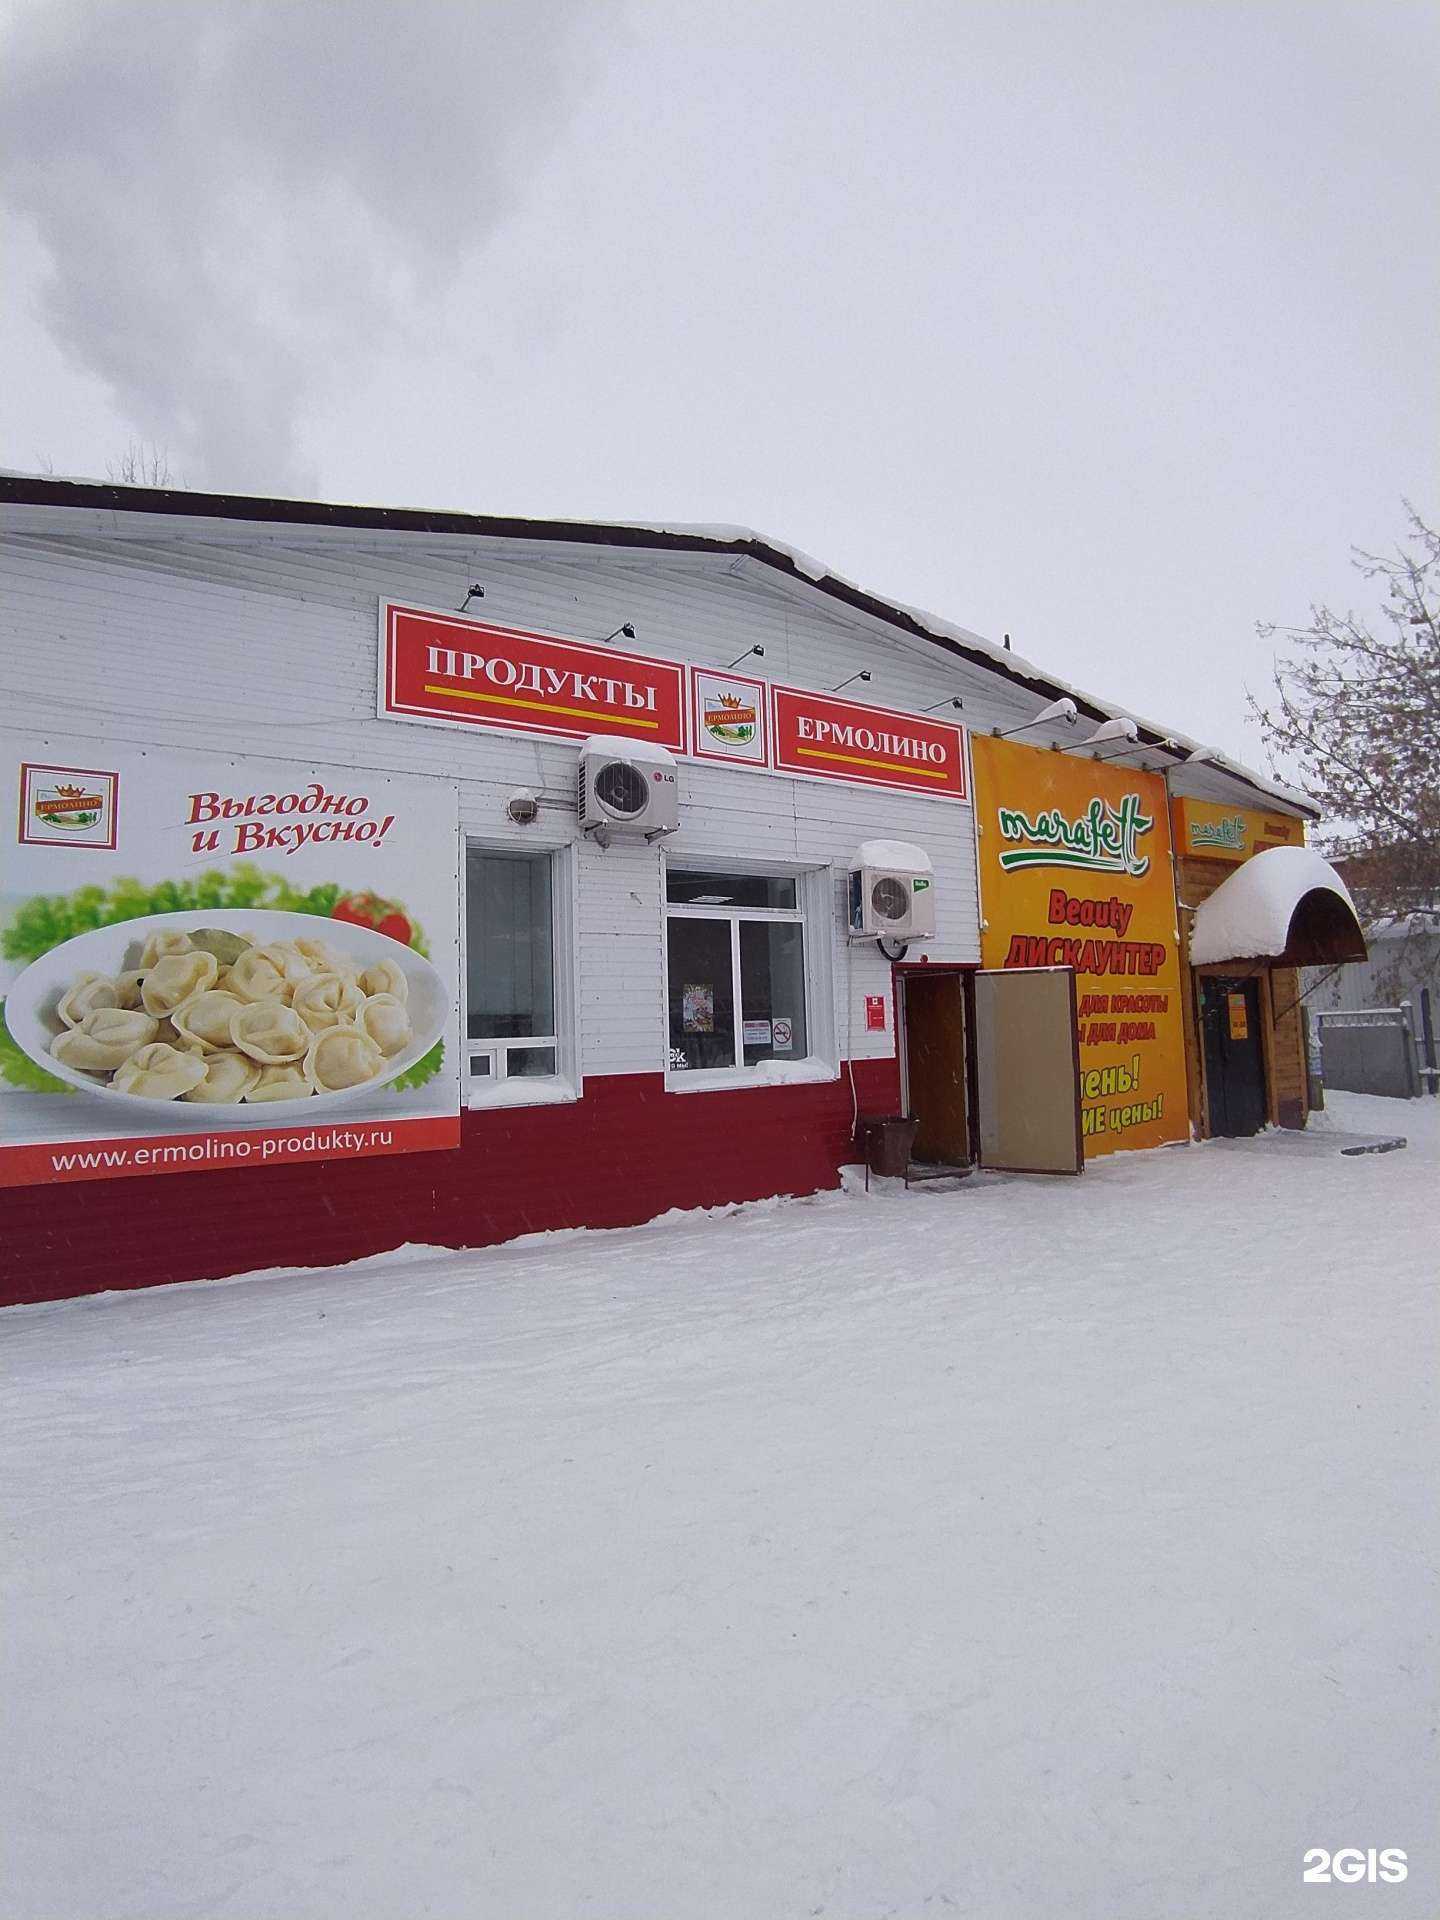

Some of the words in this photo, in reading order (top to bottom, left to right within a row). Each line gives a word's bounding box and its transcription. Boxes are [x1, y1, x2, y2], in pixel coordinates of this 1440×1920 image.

[425, 646, 658, 711] ПРОДУКТЫ
[708, 712, 752, 722] ЕРМОЛИНО
[796, 716, 947, 764] ЕРМОЛИНО
[663, 774, 675, 783] LG
[184, 783, 369, 825] Выгодно
[192, 829, 221, 852] и
[230, 815, 395, 855] Вкусно!
[998, 793, 1153, 875] marafett
[1048, 889, 1133, 937] Beauty
[1004, 935, 1166, 976] ДИСКАУНТЕР
[1117, 1022, 1156, 1044] ДОМА
[1080, 1054, 1140, 1099] ень!
[1081, 1105, 1106, 1136] ИЕ
[1109, 1093, 1163, 1133] цены!
[52, 1129, 394, 1171] www.ermolino-produkty.ru
